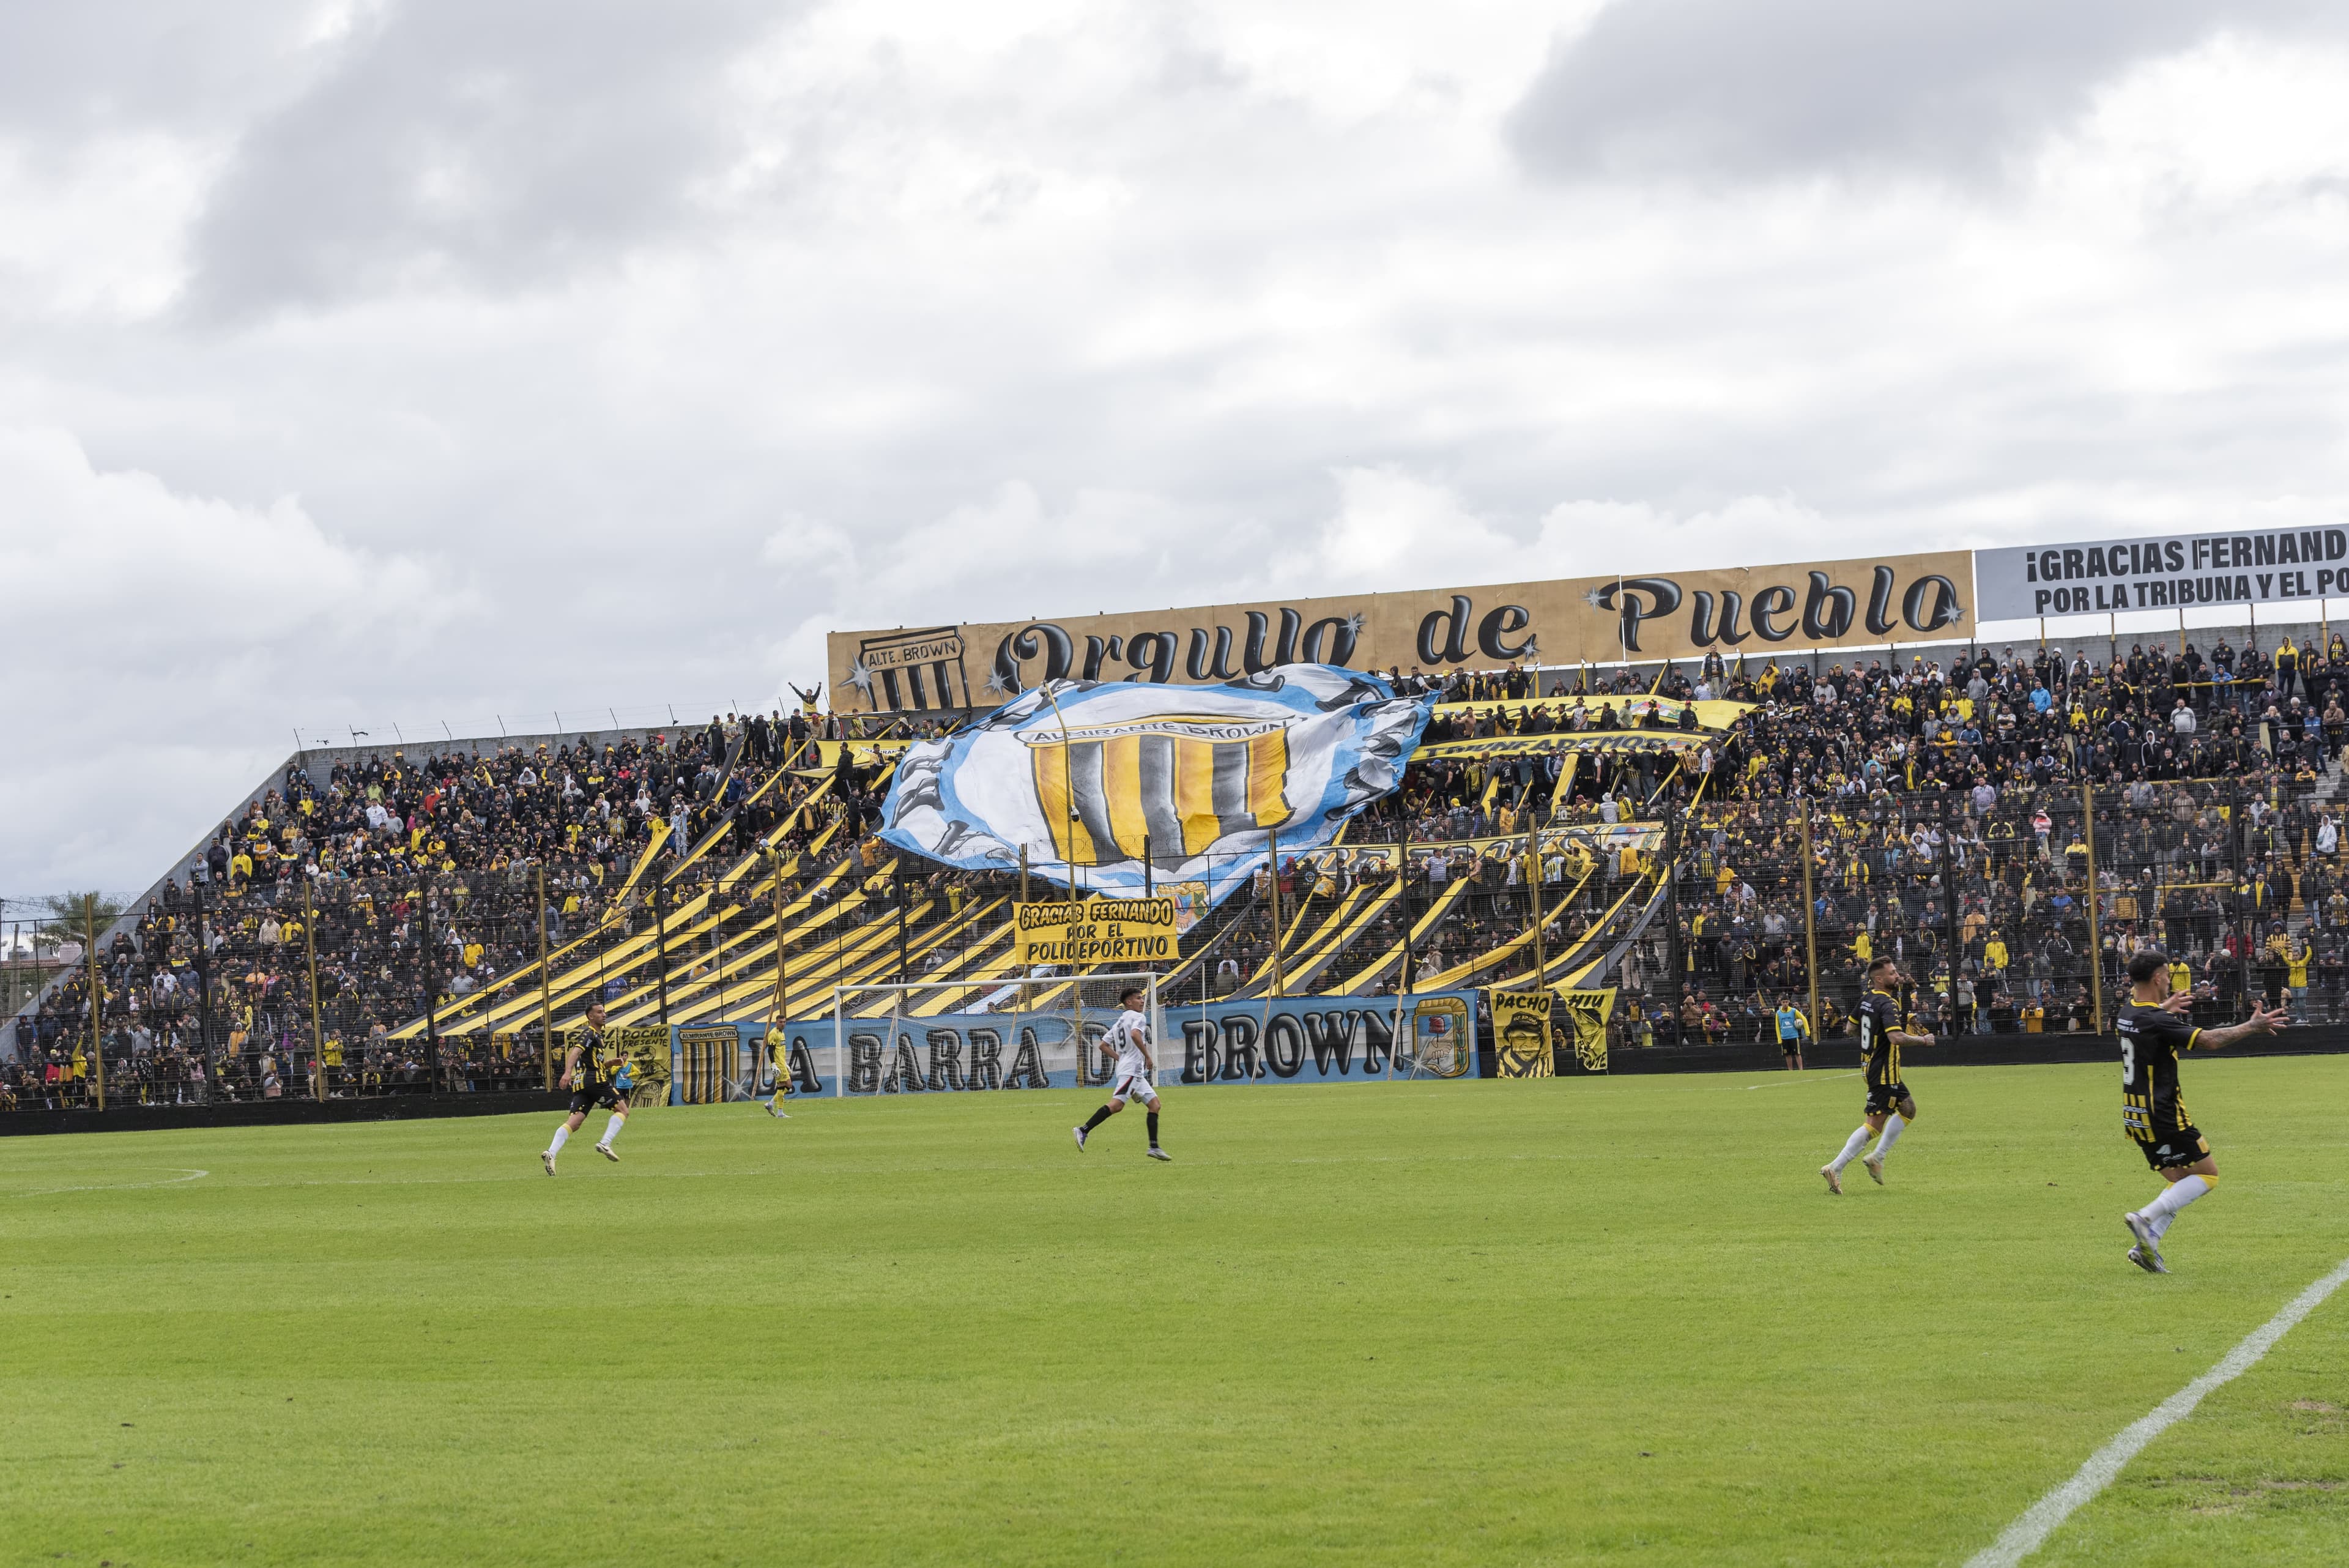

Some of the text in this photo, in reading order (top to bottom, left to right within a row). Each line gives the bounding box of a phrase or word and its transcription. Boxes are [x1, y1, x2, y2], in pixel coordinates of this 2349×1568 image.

[2035, 585, 2090, 614] POR
[2096, 583, 2129, 610] LA
[2134, 574, 2252, 605] TRIBUNA
[2255, 574, 2274, 599] Y
[2279, 571, 2311, 597] EL
[995, 565, 1958, 694] Orgullo de Pueblo
[903, 640, 957, 661] BROWN
[1033, 722, 1176, 742] ALMIRANTE
[1424, 734, 1666, 759] TRIUNFAREMOS
[1019, 899, 1174, 931] GRACIAS FERNANDO
[1108, 923, 1123, 938] EL
[1027, 937, 1168, 961] POLIDEPORTIVO
[1496, 993, 1549, 1013] PACHO
[622, 1027, 669, 1040] POCHO
[1118, 1028, 1126, 1049] 9
[1861, 1014, 1871, 1050] 6
[622, 1038, 669, 1050] PRESENTE
[748, 1035, 822, 1094] LA
[848, 1026, 1050, 1093] BARRA
[1181, 1008, 1405, 1083] BROWN
